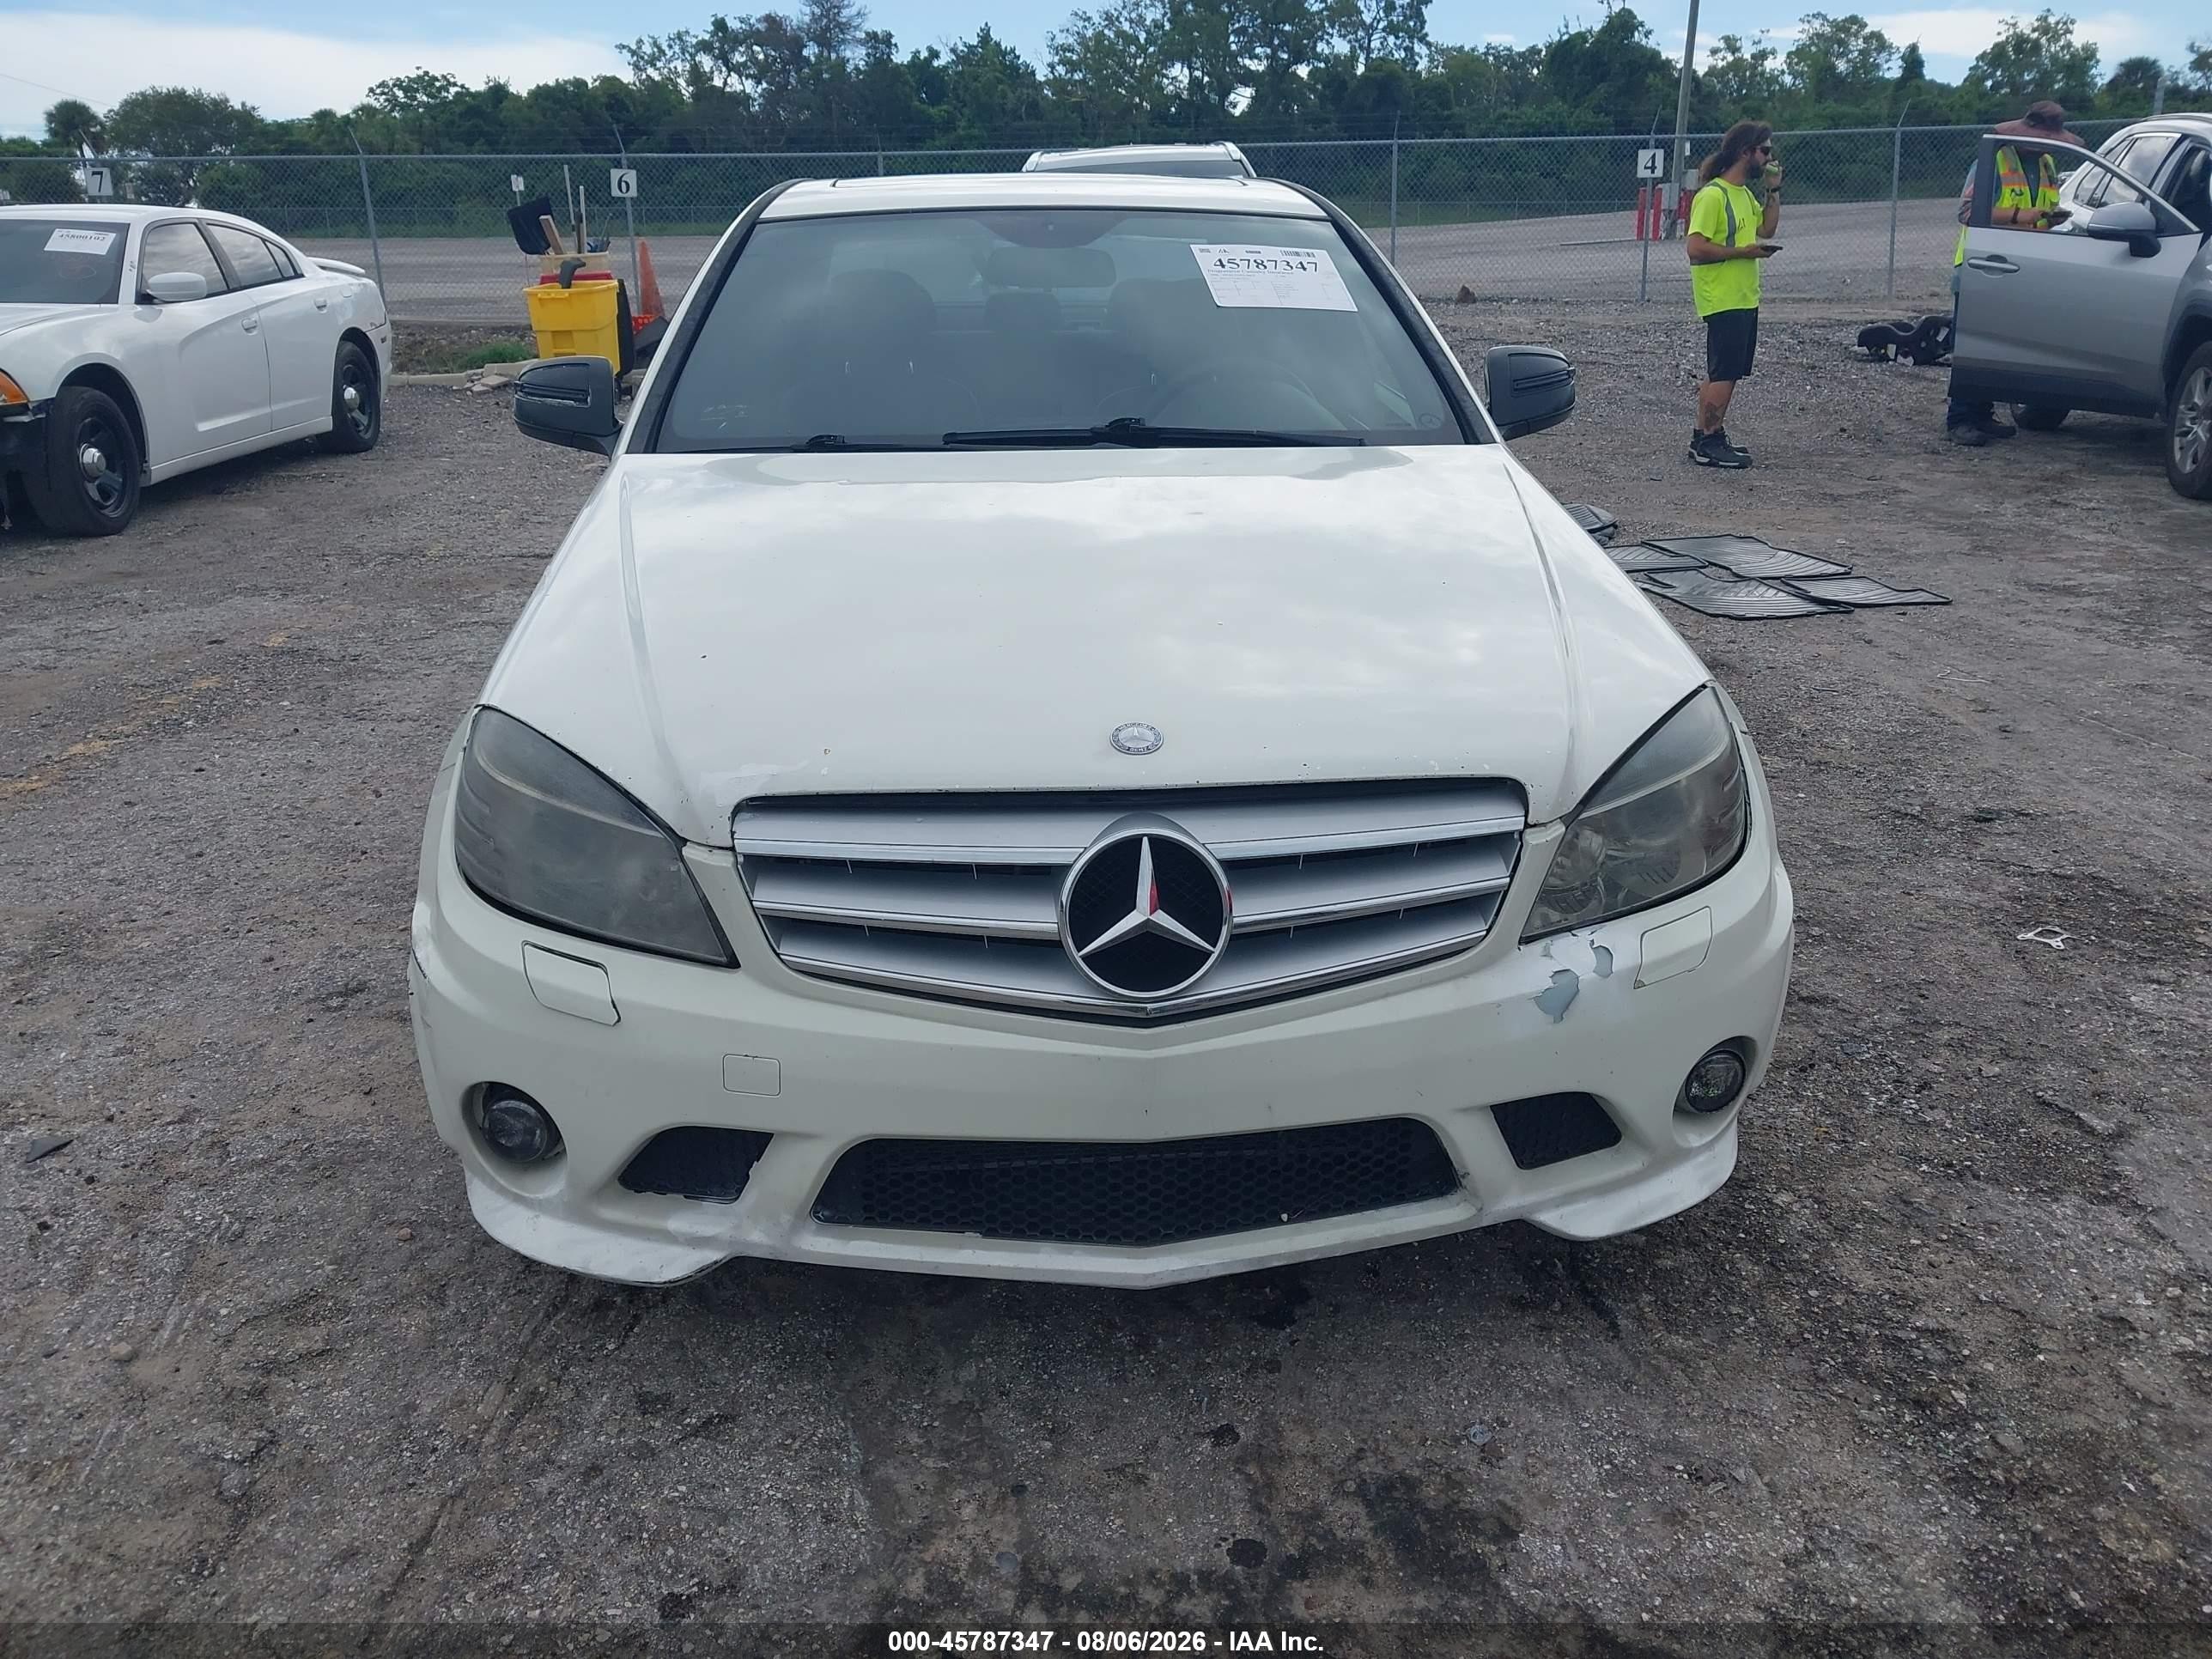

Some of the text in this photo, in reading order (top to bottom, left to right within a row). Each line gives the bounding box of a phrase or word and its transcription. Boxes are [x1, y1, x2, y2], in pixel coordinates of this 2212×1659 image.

[1644, 152, 1657, 174] 4
[92, 171, 103, 192] 7
[617, 172, 630, 194] 6
[1213, 258, 1318, 272] 45787347
